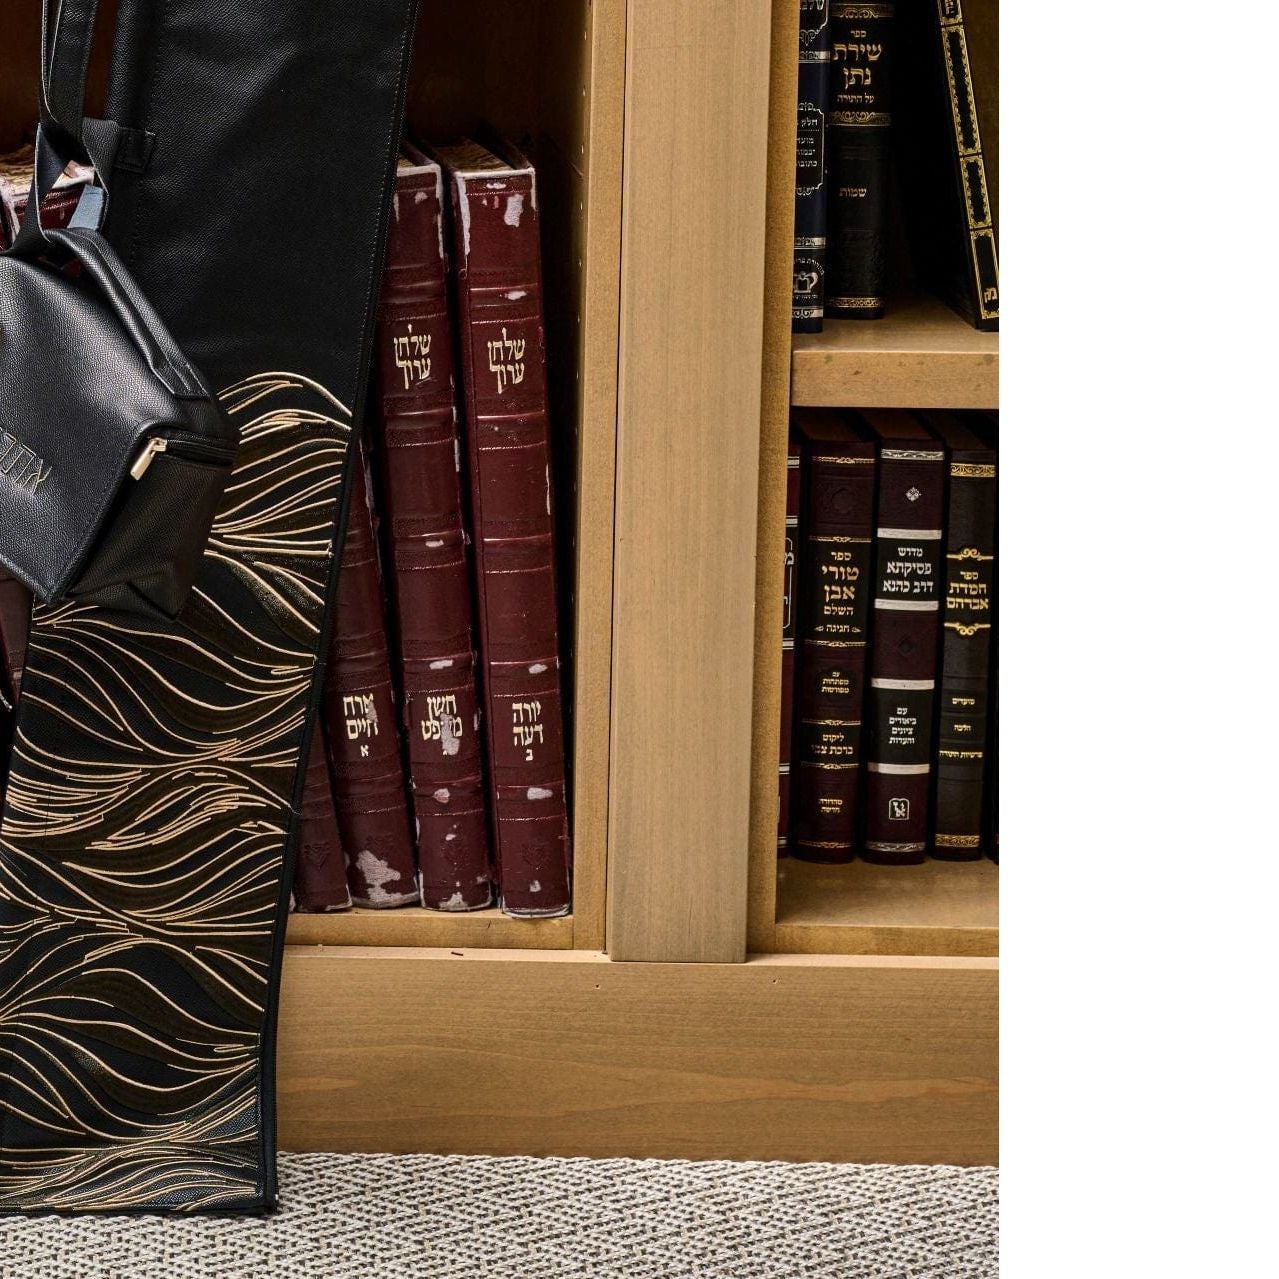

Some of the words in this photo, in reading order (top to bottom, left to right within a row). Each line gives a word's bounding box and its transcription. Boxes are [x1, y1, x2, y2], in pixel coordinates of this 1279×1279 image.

[833, 43, 883, 61] שירת
[844, 68, 872, 90] נתן
[839, 188, 867, 198] שמות
[394, 324, 431, 363] שלחן
[488, 328, 525, 367] שלחן
[396, 357, 431, 390] ערוך
[490, 362, 524, 394] ערוך
[830, 552, 852, 561] ספר
[898, 547, 924, 557] מדרש
[822, 566, 859, 581] טורי
[886, 562, 932, 577] פסיקתא
[960, 572, 978, 580] ספר
[824, 585, 856, 602] אבן
[883, 581, 910, 593] כהנא
[913, 581, 934, 593] דרב
[950, 582, 987, 594] חמדת
[824, 605, 854, 616] השלם
[946, 597, 988, 610] אברהם
[826, 624, 850, 634] חגיגה
[427, 694, 457, 721] חשן
[512, 701, 542, 723] יורה
[346, 720, 378, 740] חיים
[513, 724, 544, 746] דעה
[526, 748, 534, 761] ב
